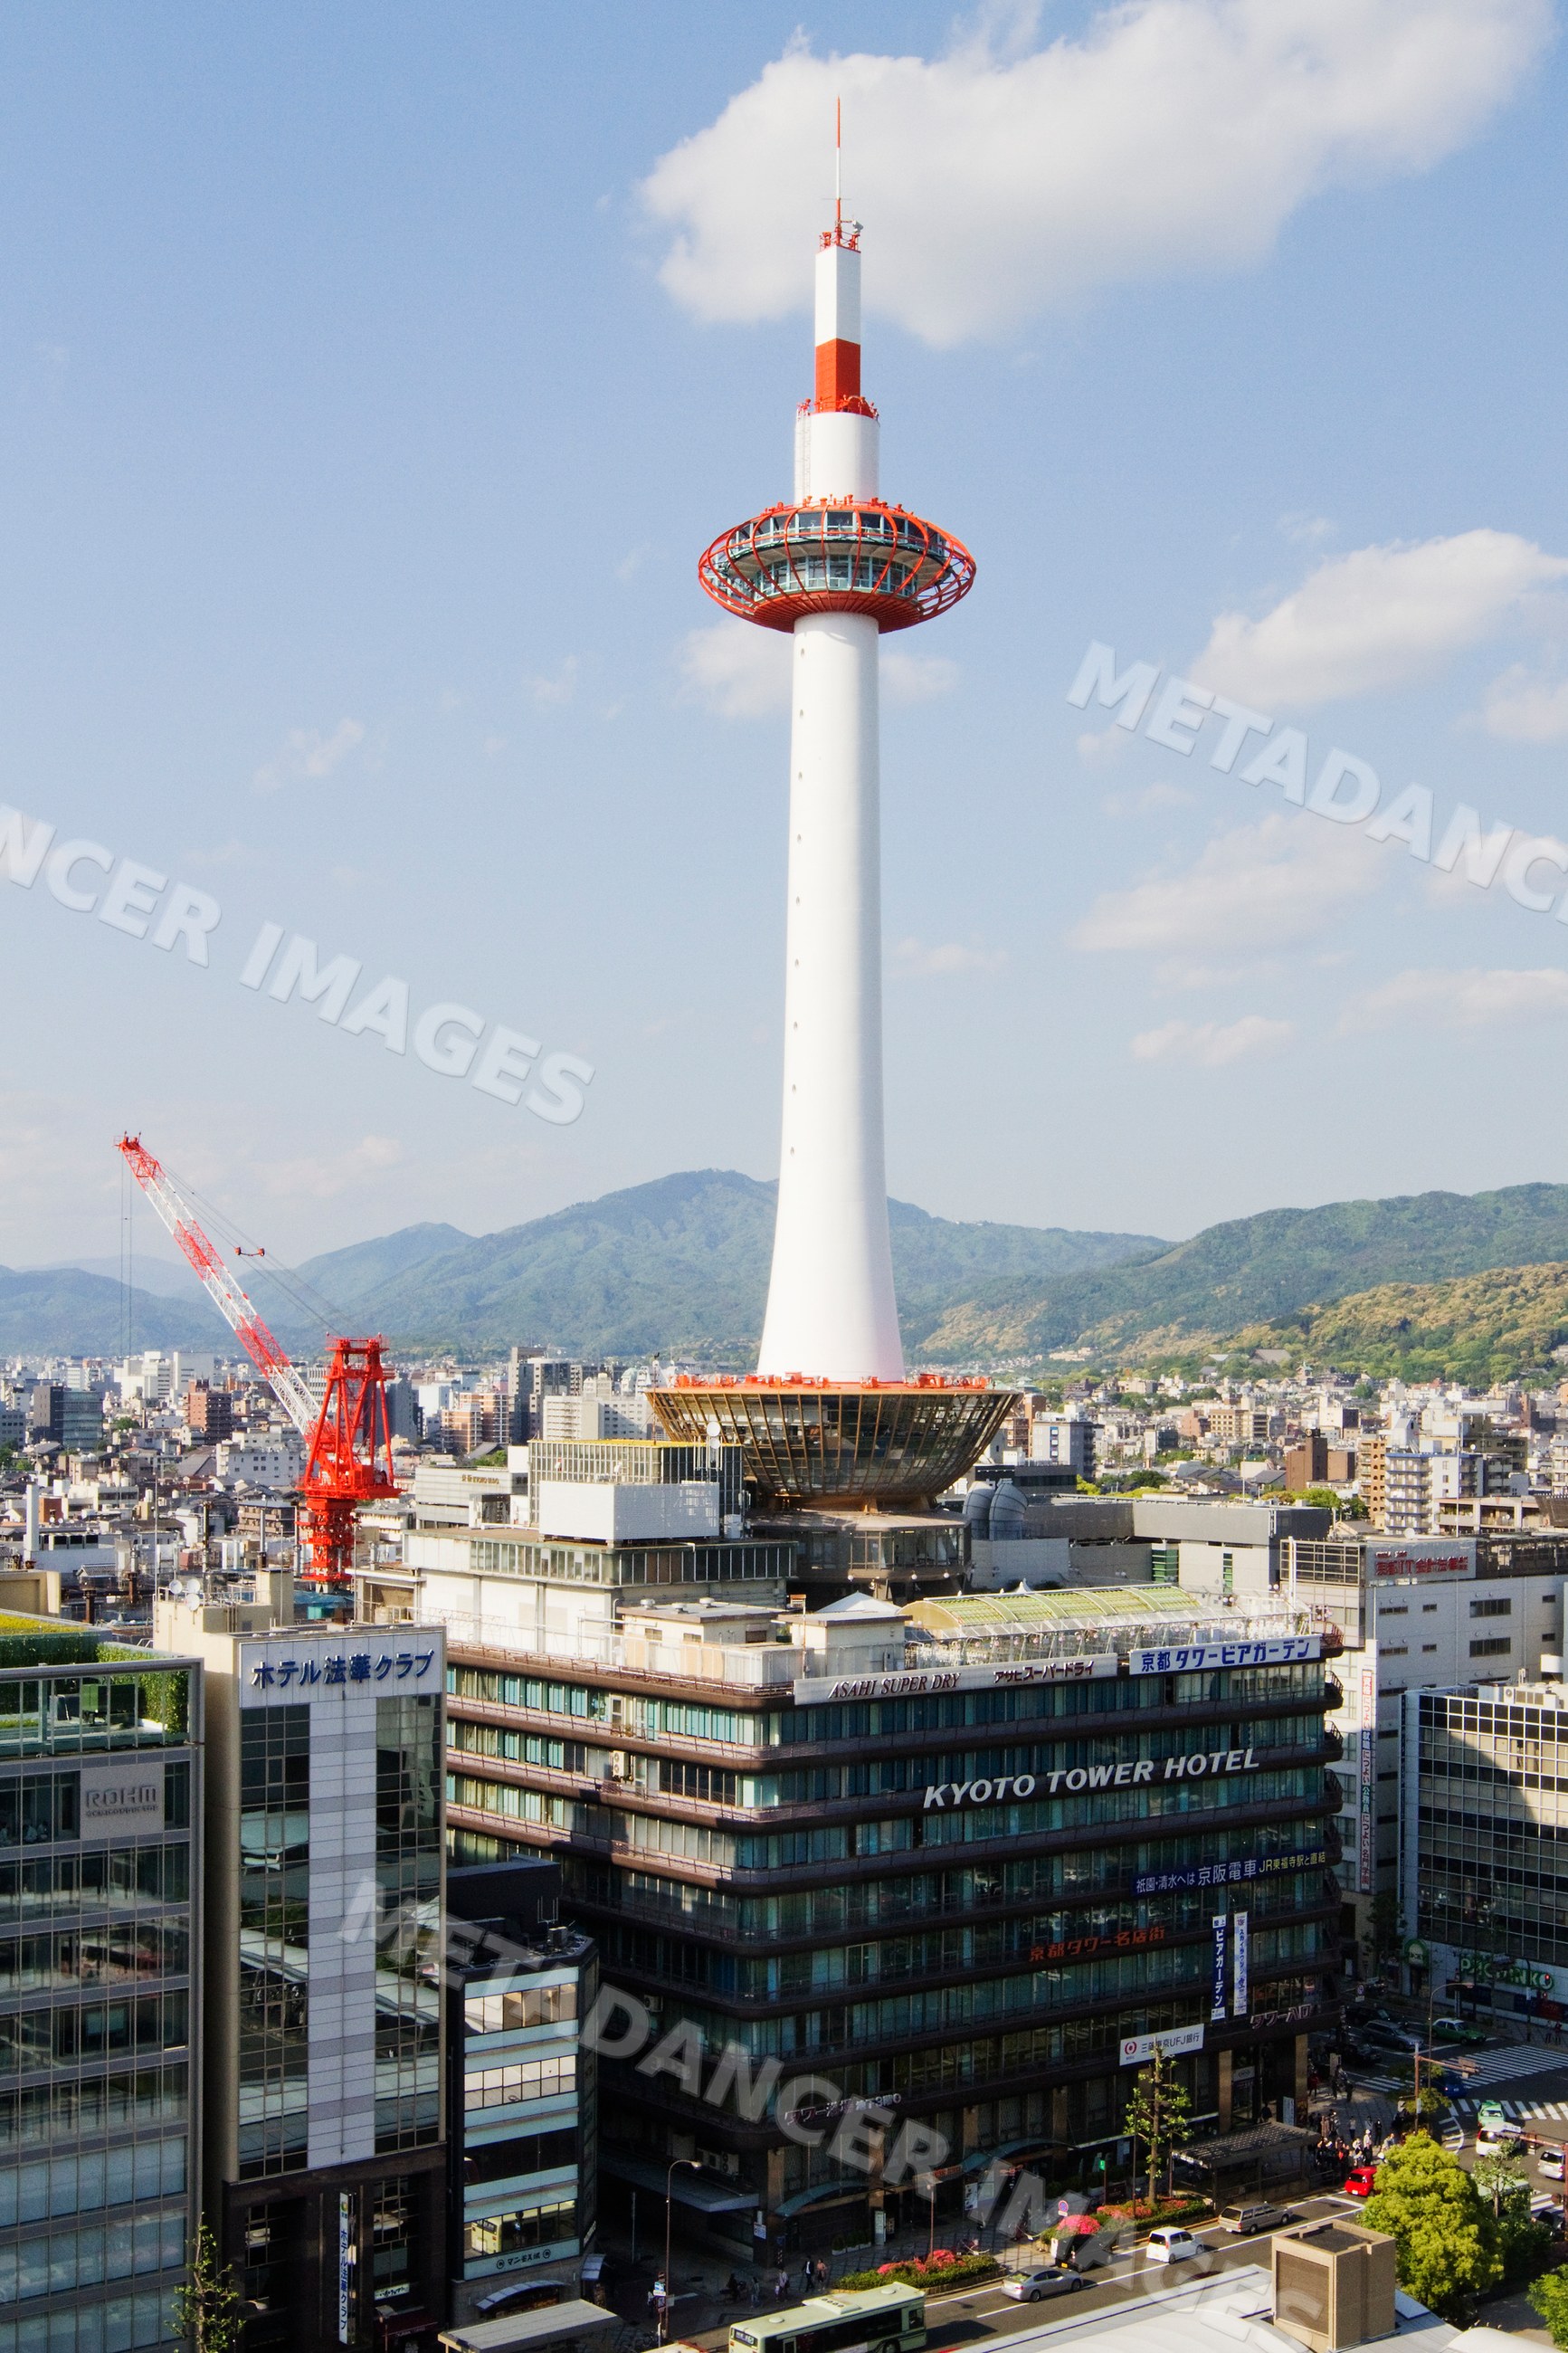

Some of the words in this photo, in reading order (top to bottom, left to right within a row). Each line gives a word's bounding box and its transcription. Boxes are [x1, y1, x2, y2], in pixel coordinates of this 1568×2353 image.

[251, 1648, 435, 1690] ホテル法華クラブ
[993, 1660, 1095, 1683] アサヒスーパードライ
[1141, 1639, 1310, 1672] 京都タワービアガーデン
[827, 1678, 876, 1700] ASAHI
[880, 1674, 927, 1695] SUPER
[930, 1672, 962, 1691] DRY
[923, 1774, 1036, 1808] KYOTO
[1046, 1759, 1154, 1793] TOWER
[1164, 1748, 1259, 1778] HOTEL
[86, 1784, 157, 1808] ROHM
[1197, 1859, 1258, 1887] 京阪電車
[1029, 1925, 1165, 1963] 京都タワー名店街
[1214, 1929, 1224, 2007] ビアガーデン
